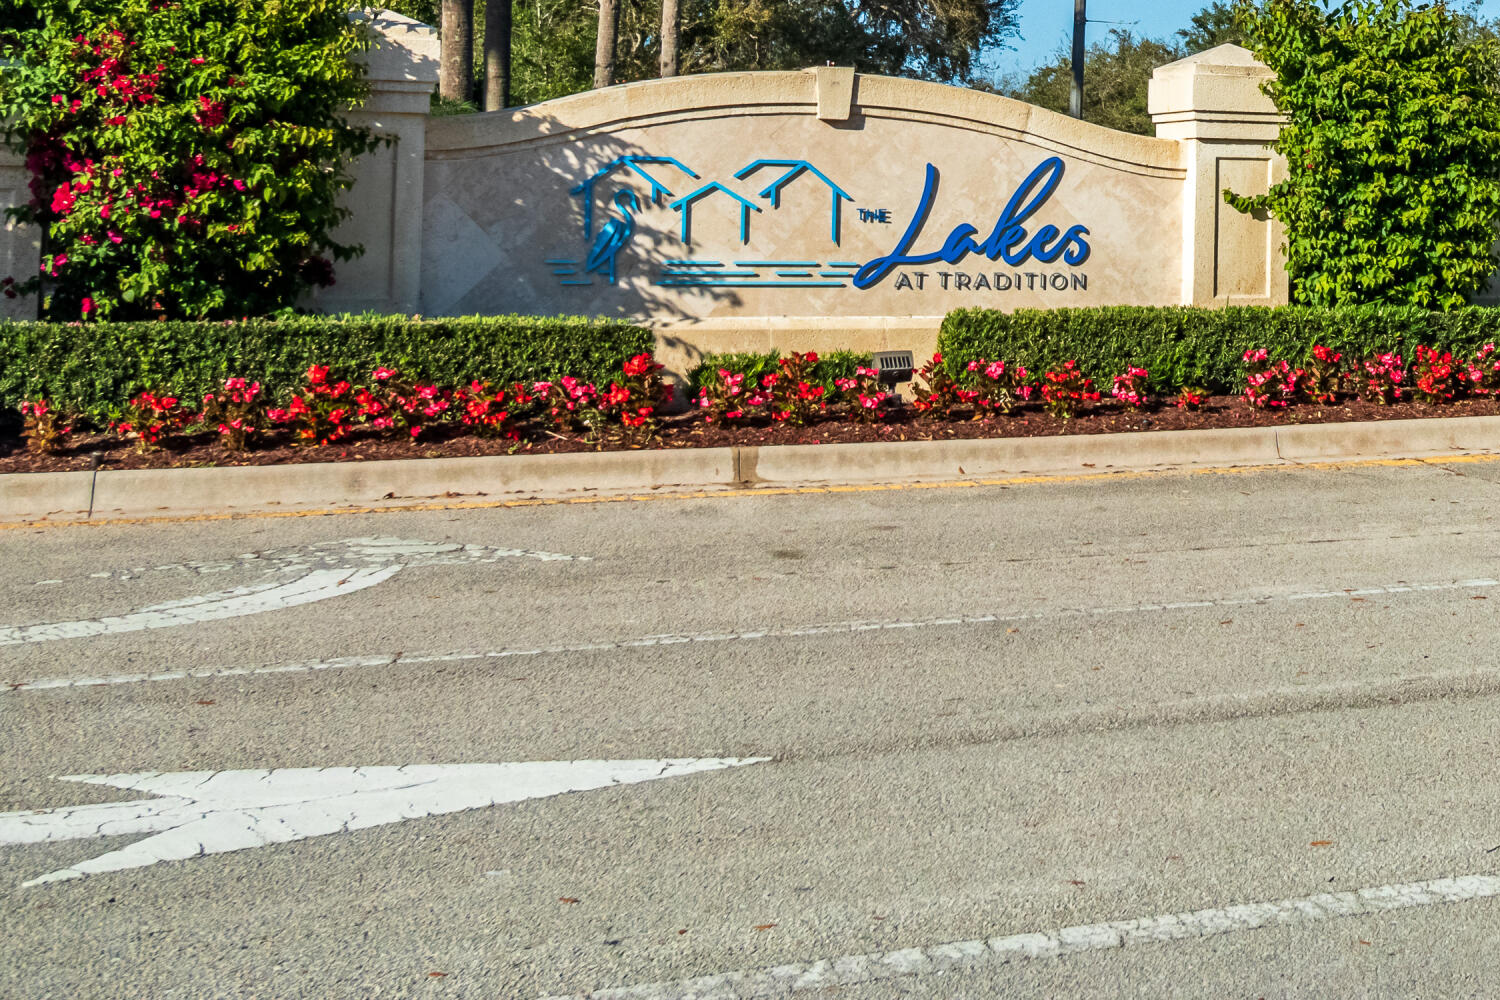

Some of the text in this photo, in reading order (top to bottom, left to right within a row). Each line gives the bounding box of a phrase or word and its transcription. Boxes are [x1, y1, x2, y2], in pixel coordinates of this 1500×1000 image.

[853, 156, 1090, 290] THE Lakes
[894, 272, 1087, 290] AT TRADITION
